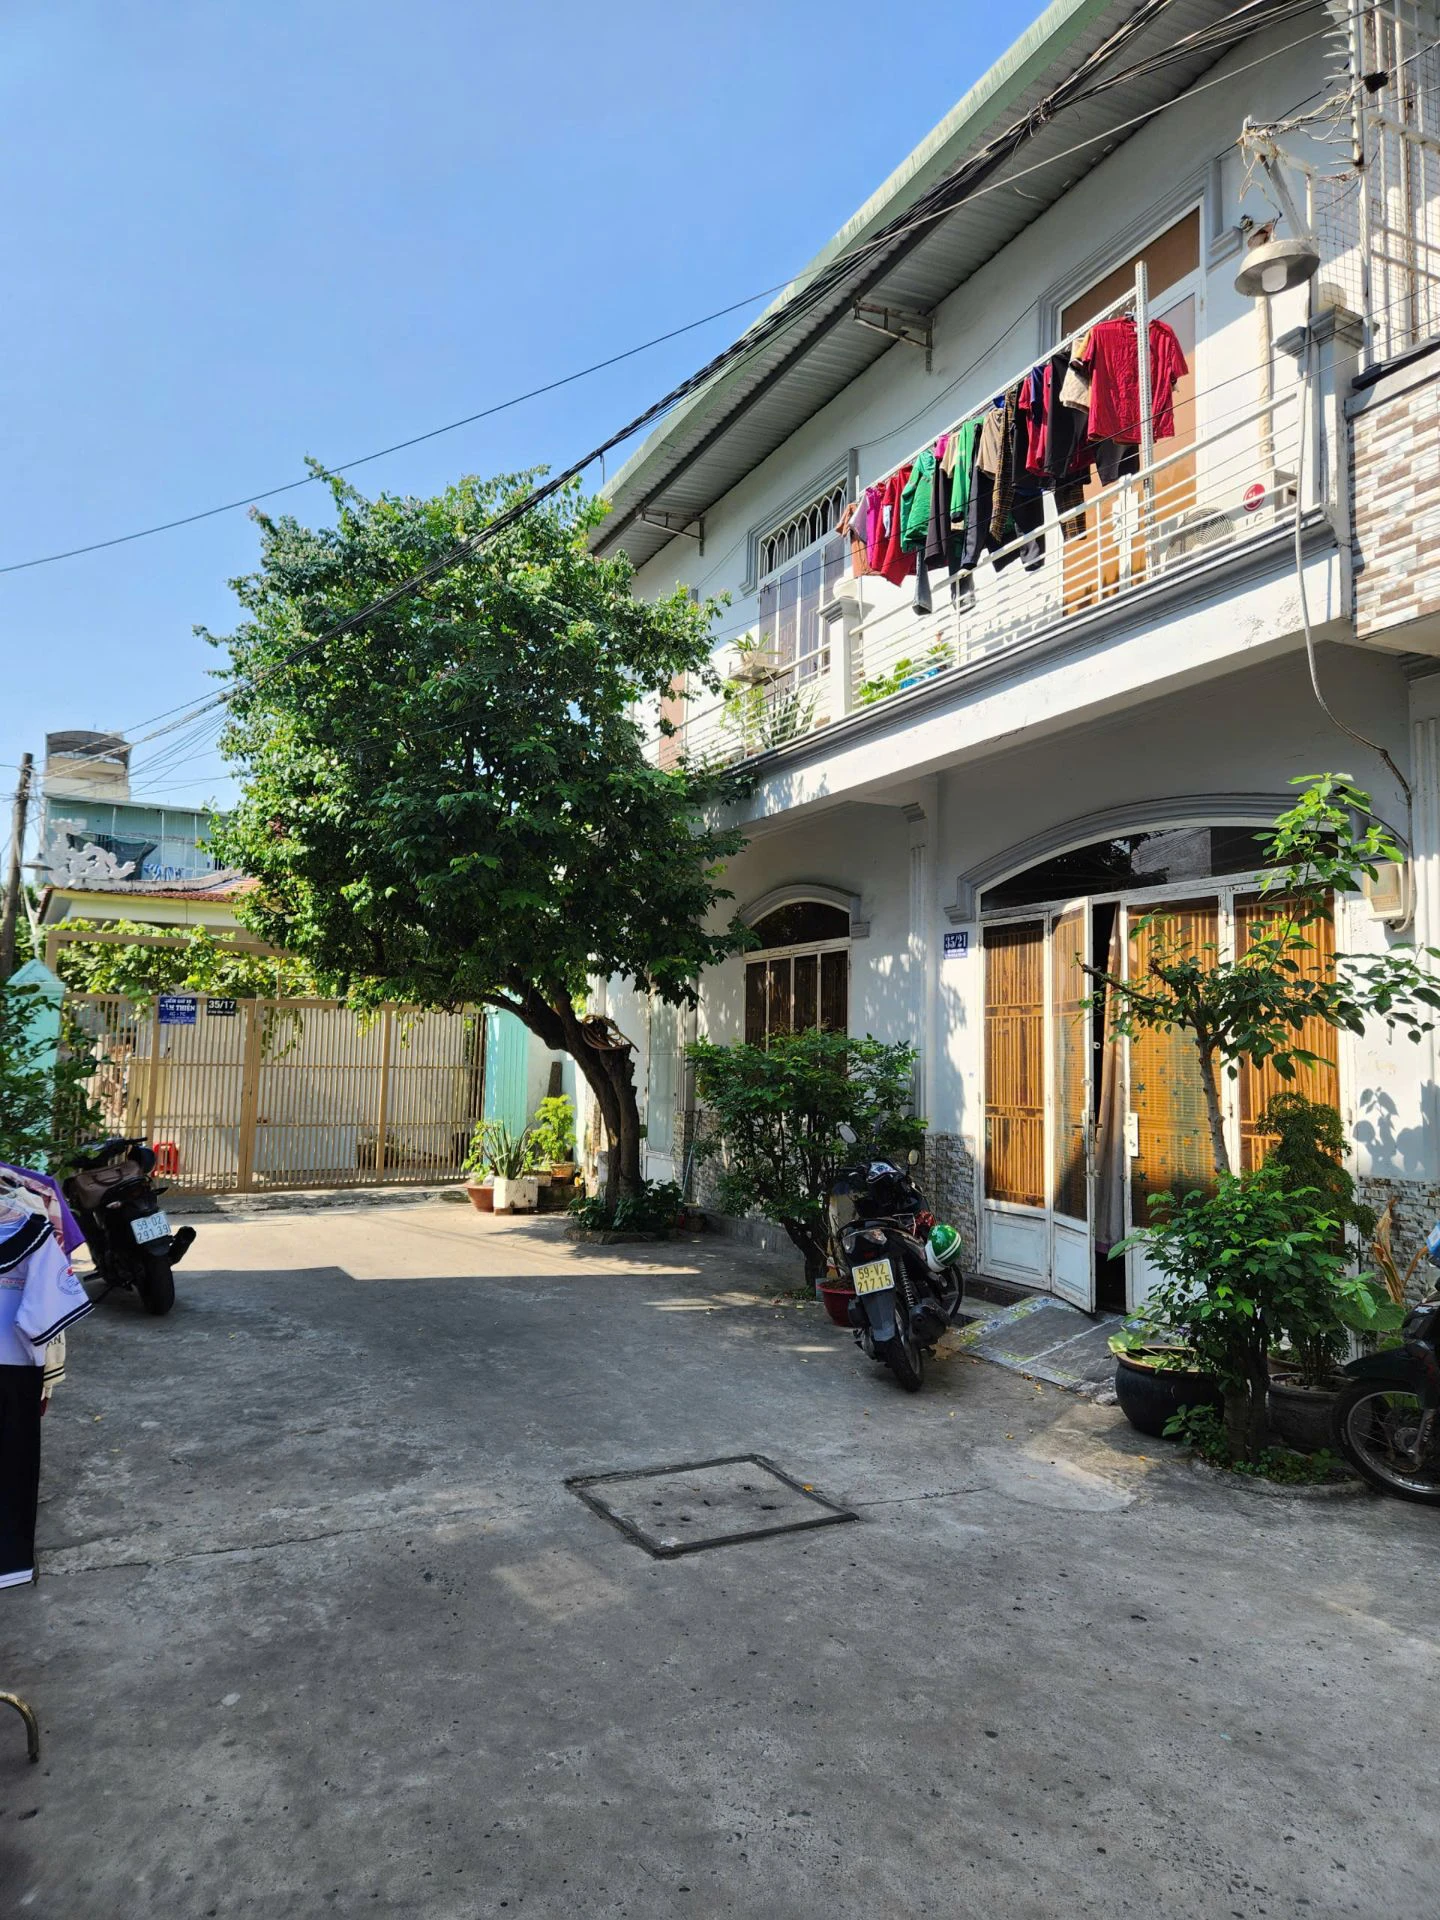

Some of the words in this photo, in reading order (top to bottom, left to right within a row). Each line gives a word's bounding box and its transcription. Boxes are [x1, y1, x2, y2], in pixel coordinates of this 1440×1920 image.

[945, 934, 966, 949] 35/21
[208, 1000, 235, 1009] 35/17
[858, 1263, 885, 1280] 59-V2
[857, 1274, 891, 1293] 217.15
